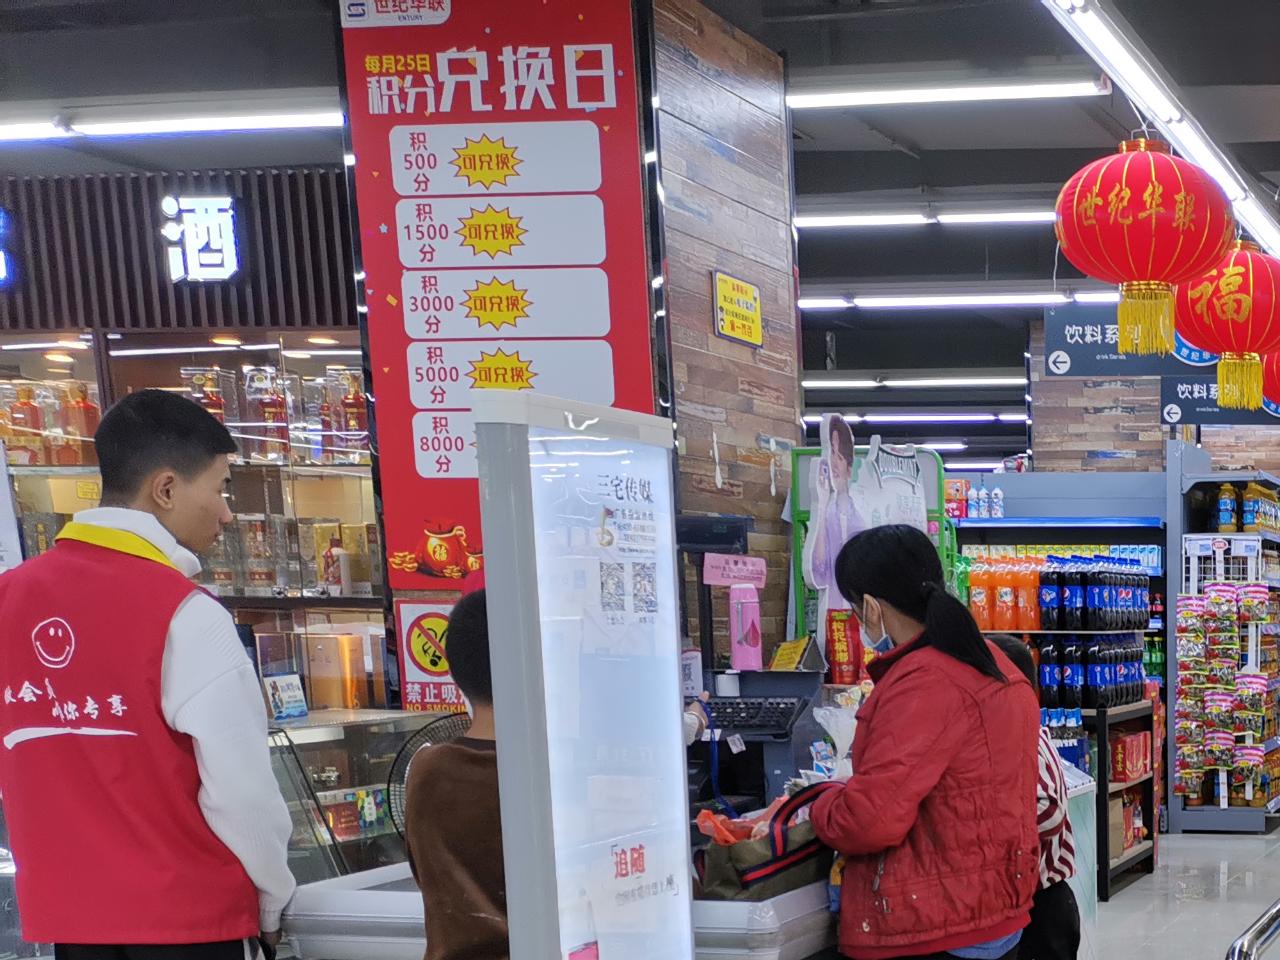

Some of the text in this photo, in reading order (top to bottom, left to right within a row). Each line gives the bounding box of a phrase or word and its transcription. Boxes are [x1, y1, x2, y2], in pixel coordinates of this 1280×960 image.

[365, 53, 431, 74] 每月25日
[408, 131, 429, 152] 积
[403, 153, 437, 170] 500
[461, 149, 511, 173] 可兑换
[413, 174, 431, 193] 分
[415, 203, 434, 223] 积
[1079, 180, 1195, 232] 世纪华联
[161, 196, 240, 283] 酒
[403, 224, 449, 241] 1500
[467, 220, 516, 242] 可兑换
[419, 245, 437, 263] 分
[420, 275, 439, 294] 积
[1190, 265, 1251, 324] 福
[409, 295, 454, 313] 3000
[472, 291, 521, 314] 可兑换
[425, 315, 442, 334] 分
[425, 346, 445, 366] 积
[415, 366, 459, 384] 5000
[478, 363, 526, 386] 可兑换
[430, 386, 447, 405] 分
[431, 415, 450, 435] 积
[419, 435, 464, 453] 8000
[435, 456, 452, 474] 分
[597, 473, 655, 504] 三宅传媒
[406, 704, 466, 714] NO SMOKIN
